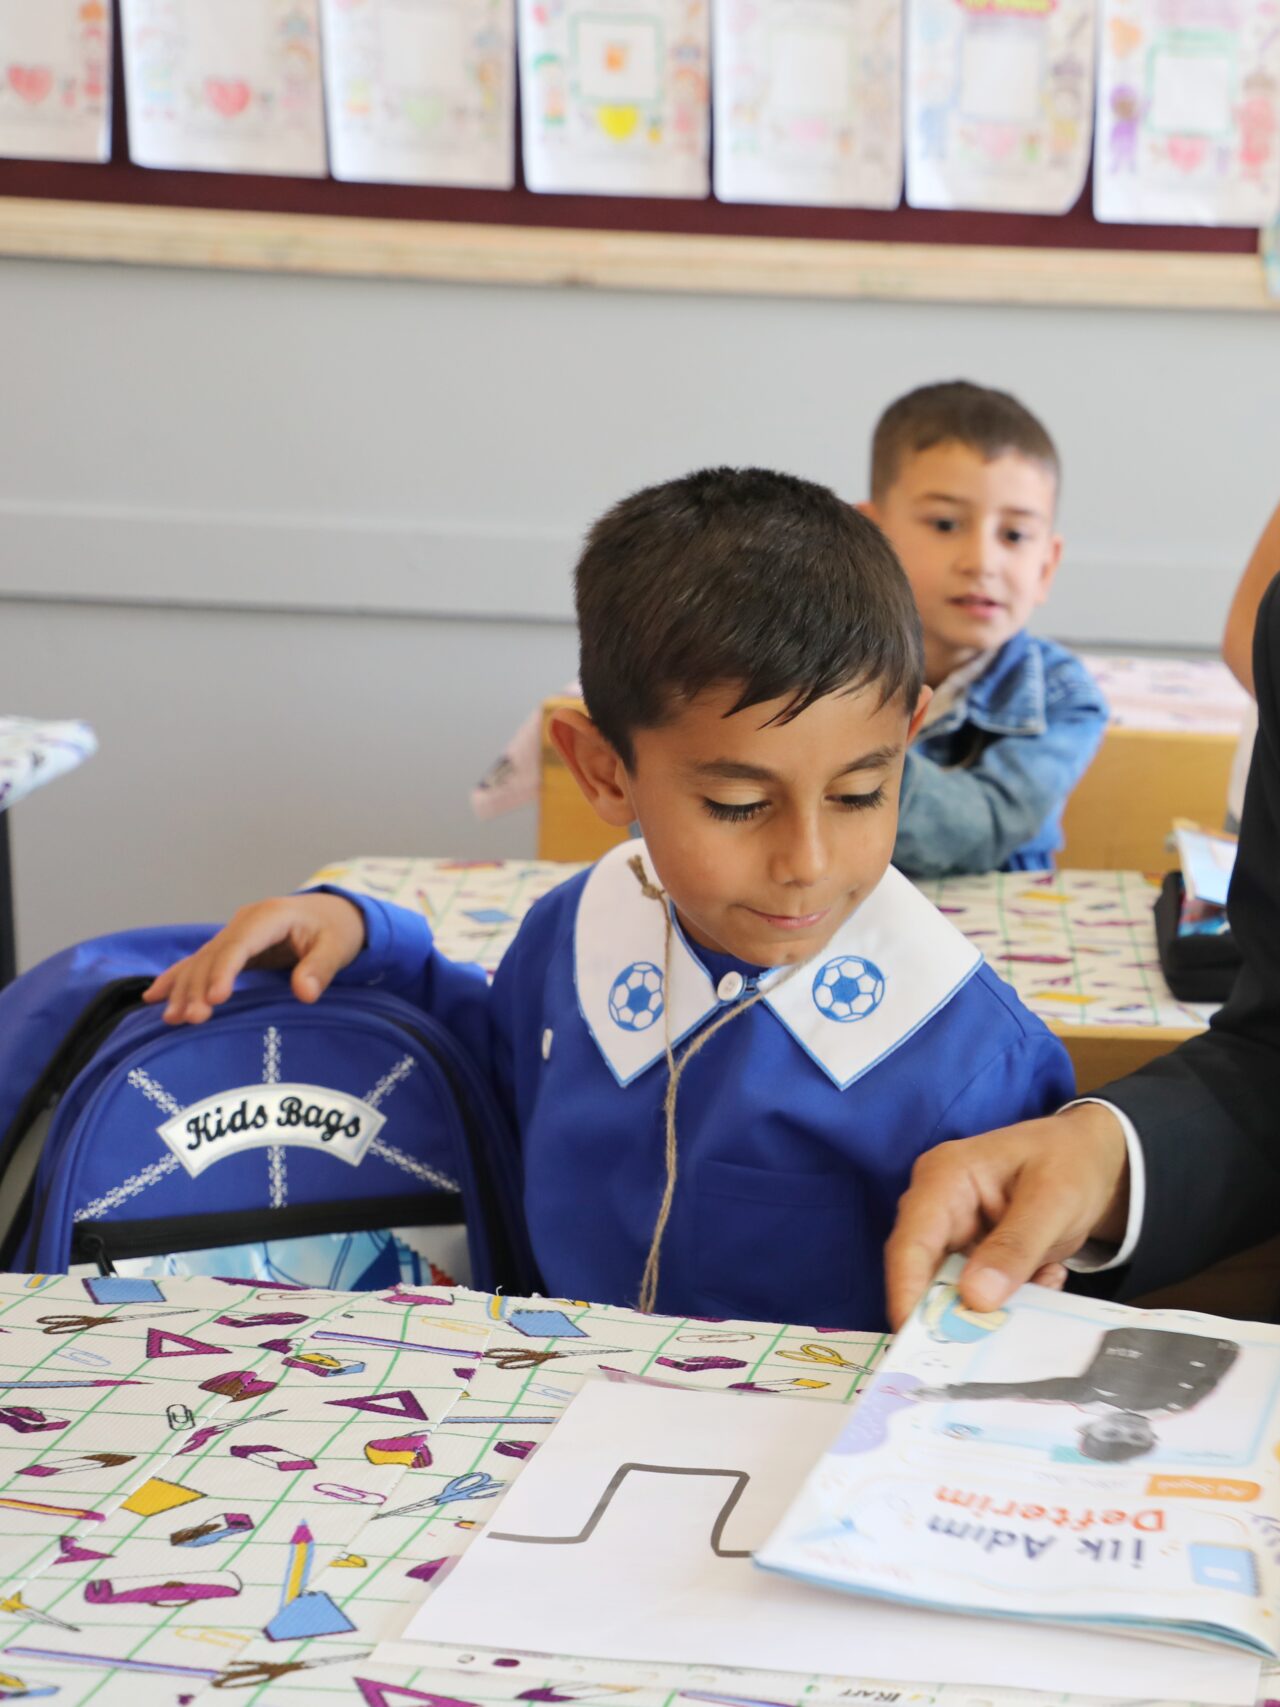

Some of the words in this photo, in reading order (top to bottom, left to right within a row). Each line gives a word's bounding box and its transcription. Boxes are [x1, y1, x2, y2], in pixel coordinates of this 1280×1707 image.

[186, 1100, 268, 1151] Kids
[277, 1096, 361, 1142] Bags
[935, 1485, 1165, 1532] Defterim
[927, 1513, 1056, 1560] Adım
[1077, 1537, 1145, 1569] İlk
